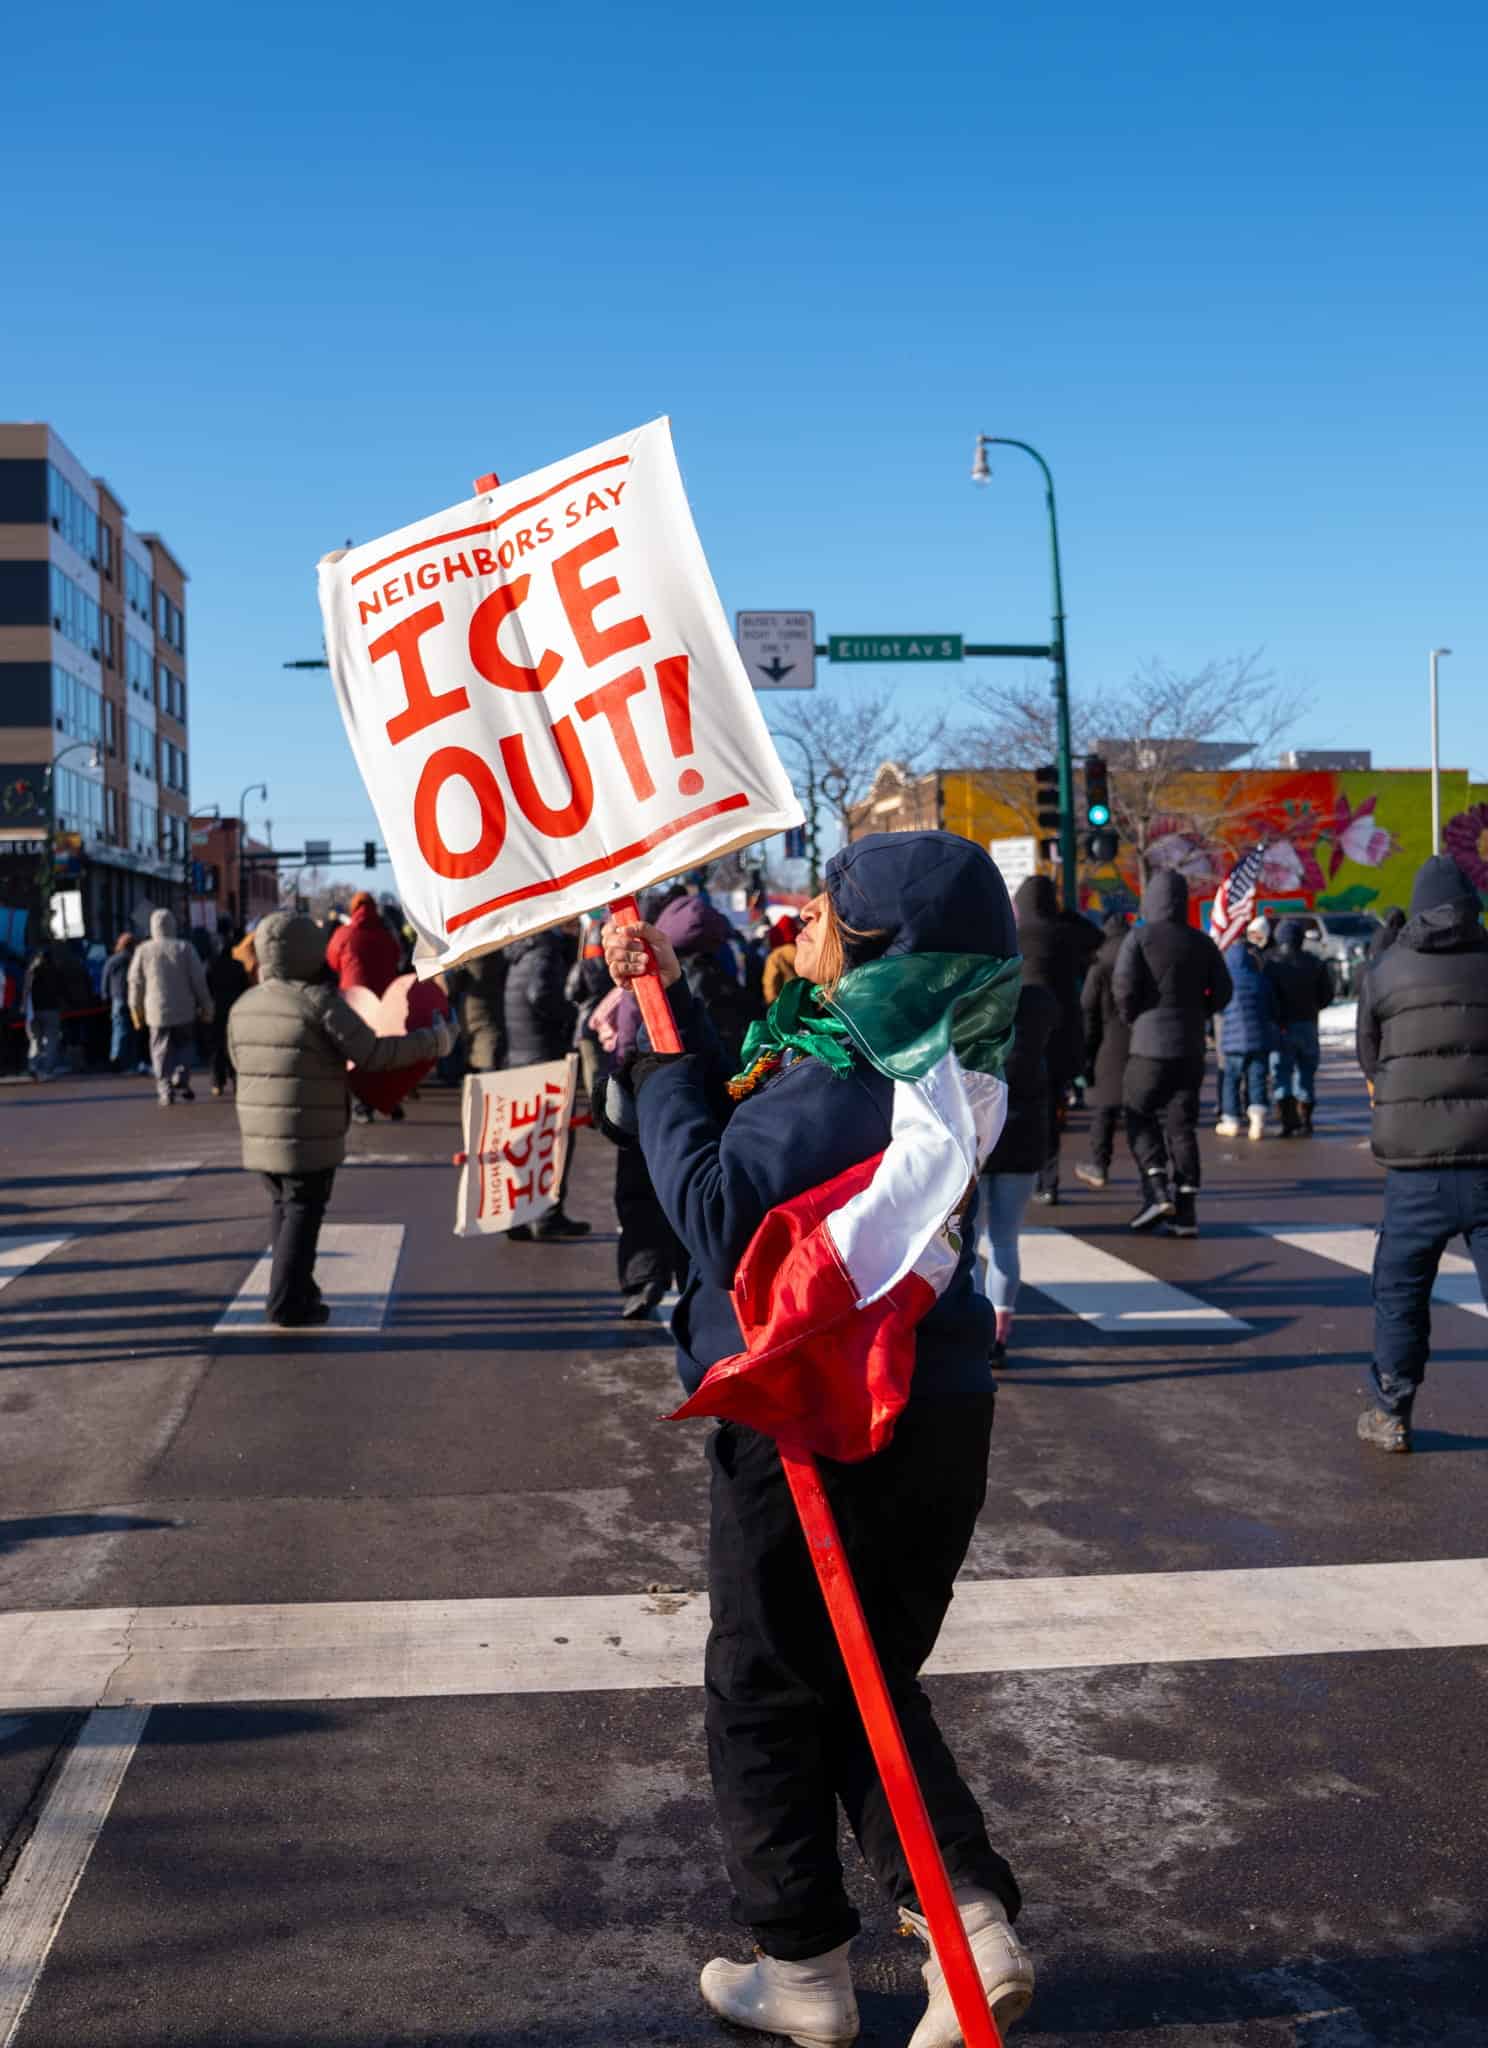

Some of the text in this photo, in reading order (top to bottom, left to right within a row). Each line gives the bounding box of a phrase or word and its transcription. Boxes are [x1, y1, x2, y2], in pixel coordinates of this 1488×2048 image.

[357, 481, 627, 625] NEIGHBORS SAY
[367, 527, 652, 747] ICE
[838, 640, 953, 657] Elliot Av S
[413, 655, 705, 881] OUT!
[503, 1094, 541, 1209] ICE
